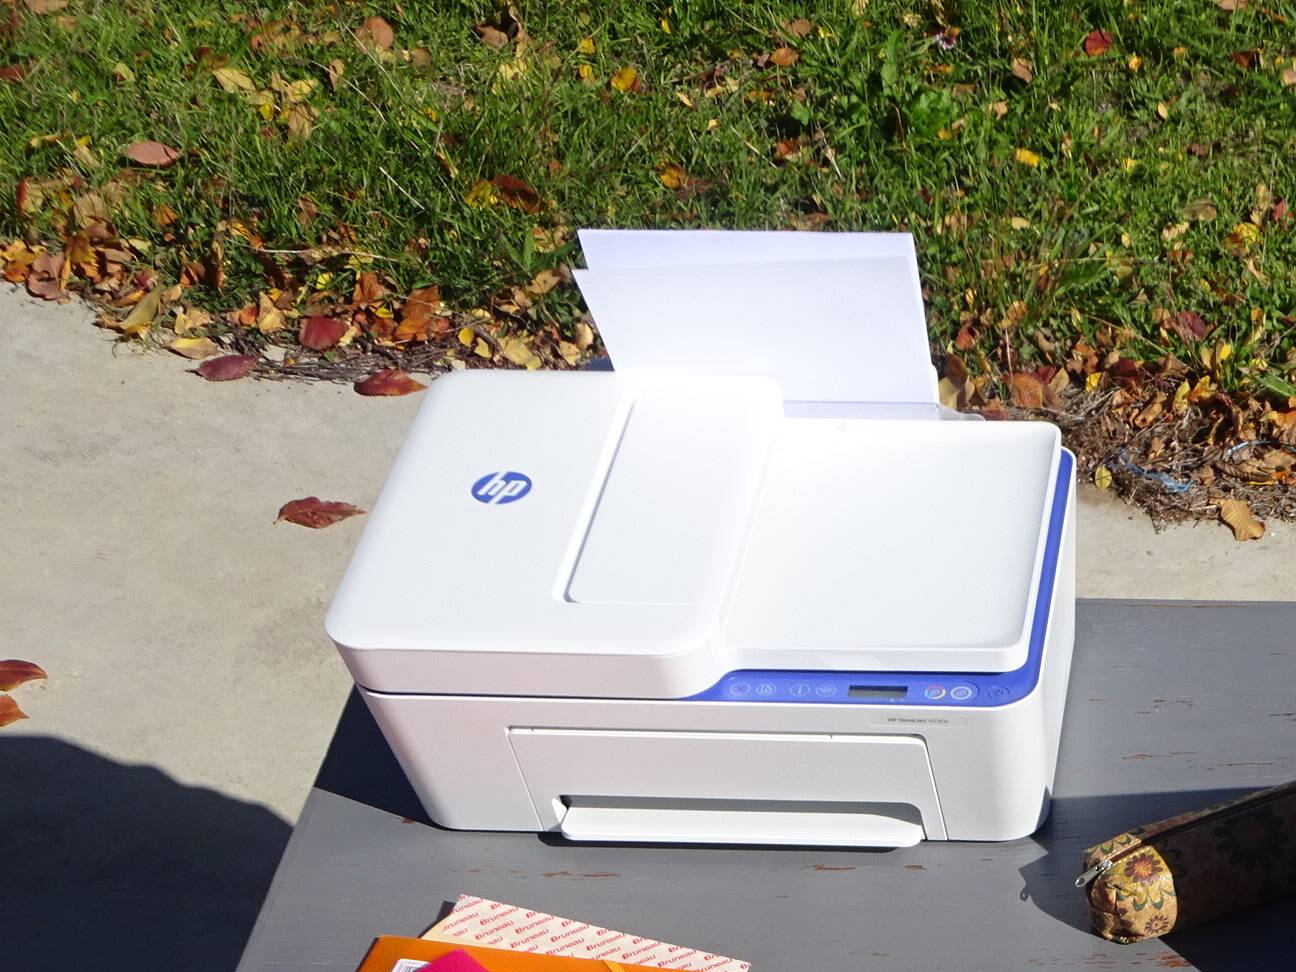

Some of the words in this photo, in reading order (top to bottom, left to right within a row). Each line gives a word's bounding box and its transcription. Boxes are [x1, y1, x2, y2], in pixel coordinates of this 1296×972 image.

[471, 471, 532, 504] hp
[452, 897, 483, 914] runeau
[480, 906, 518, 926] Bruneau
[475, 920, 514, 940] Bruneau
[510, 928, 550, 949] Bruneau
[586, 932, 626, 952] Bruneau
[622, 941, 662, 960] Bruneau
